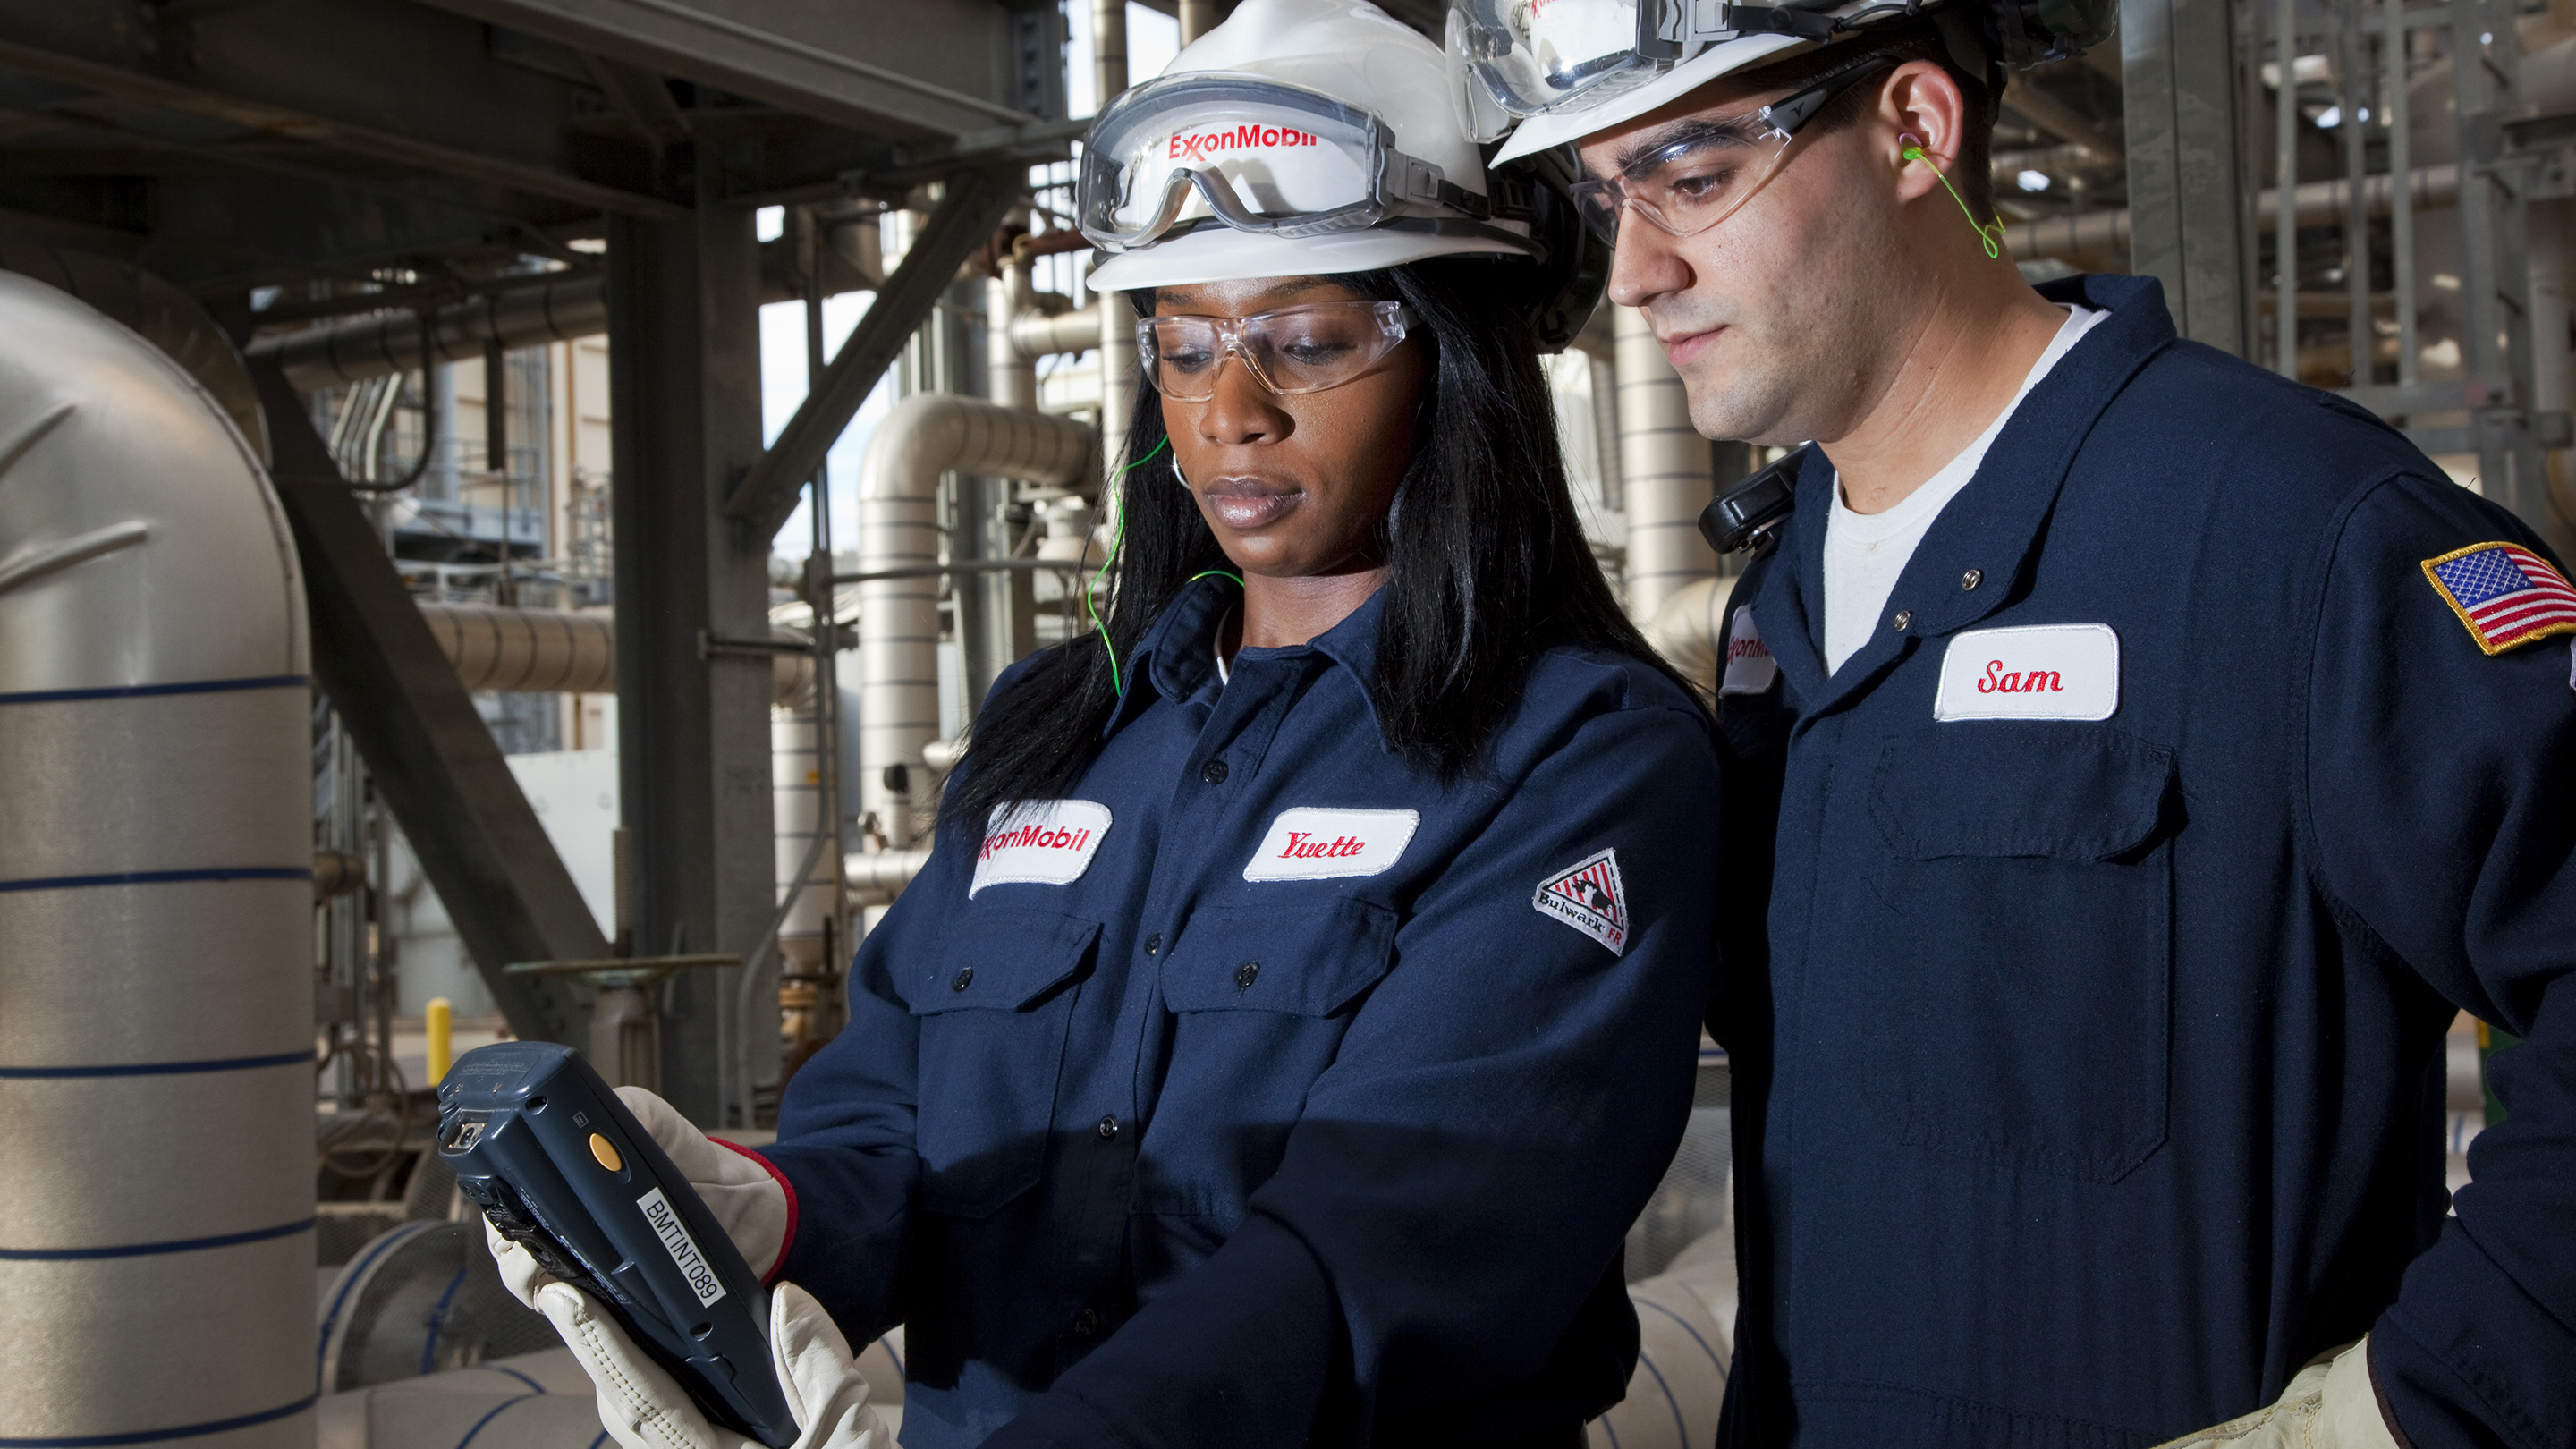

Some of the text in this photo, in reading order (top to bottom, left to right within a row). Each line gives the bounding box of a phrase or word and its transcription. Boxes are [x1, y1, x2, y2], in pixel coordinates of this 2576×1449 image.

[1169, 124, 1317, 162] ExxonMobil
[1978, 659, 2064, 693] Sam
[1538, 892, 1622, 945] Bulwark FR
[646, 1200, 717, 1299] BMTINT089
